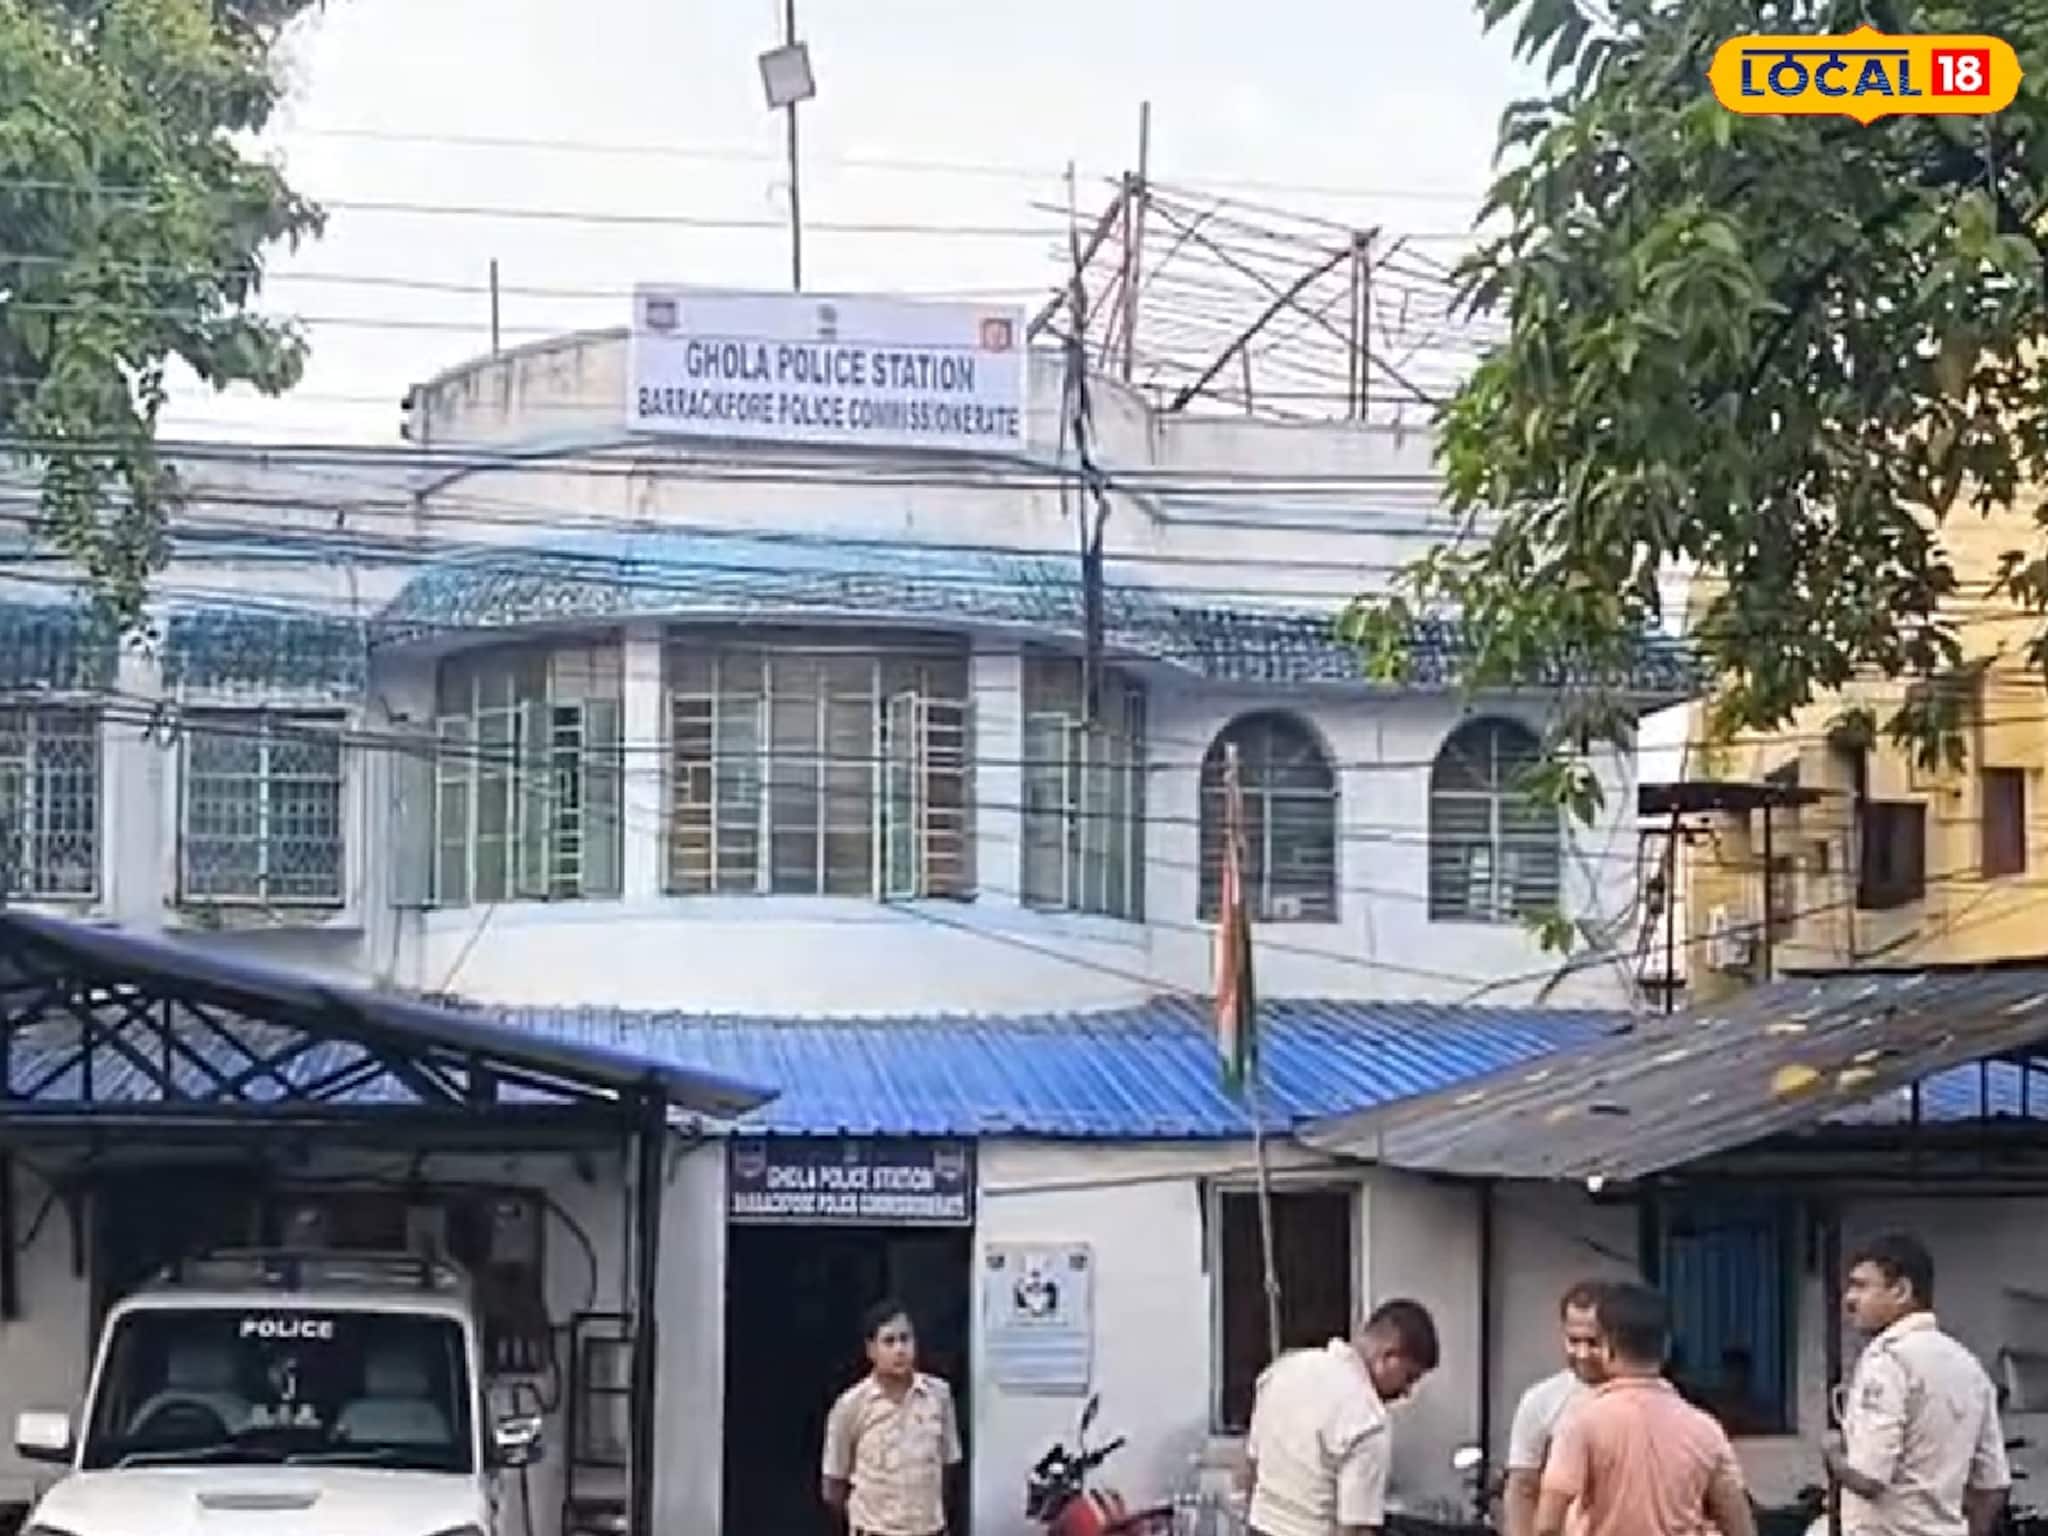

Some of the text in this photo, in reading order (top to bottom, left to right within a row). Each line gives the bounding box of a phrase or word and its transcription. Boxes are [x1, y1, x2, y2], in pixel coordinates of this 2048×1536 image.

[685, 341, 976, 393] GHOLA POLICE STATION
[778, 392, 844, 428] POLICE
[239, 1318, 334, 1340] POLICE
